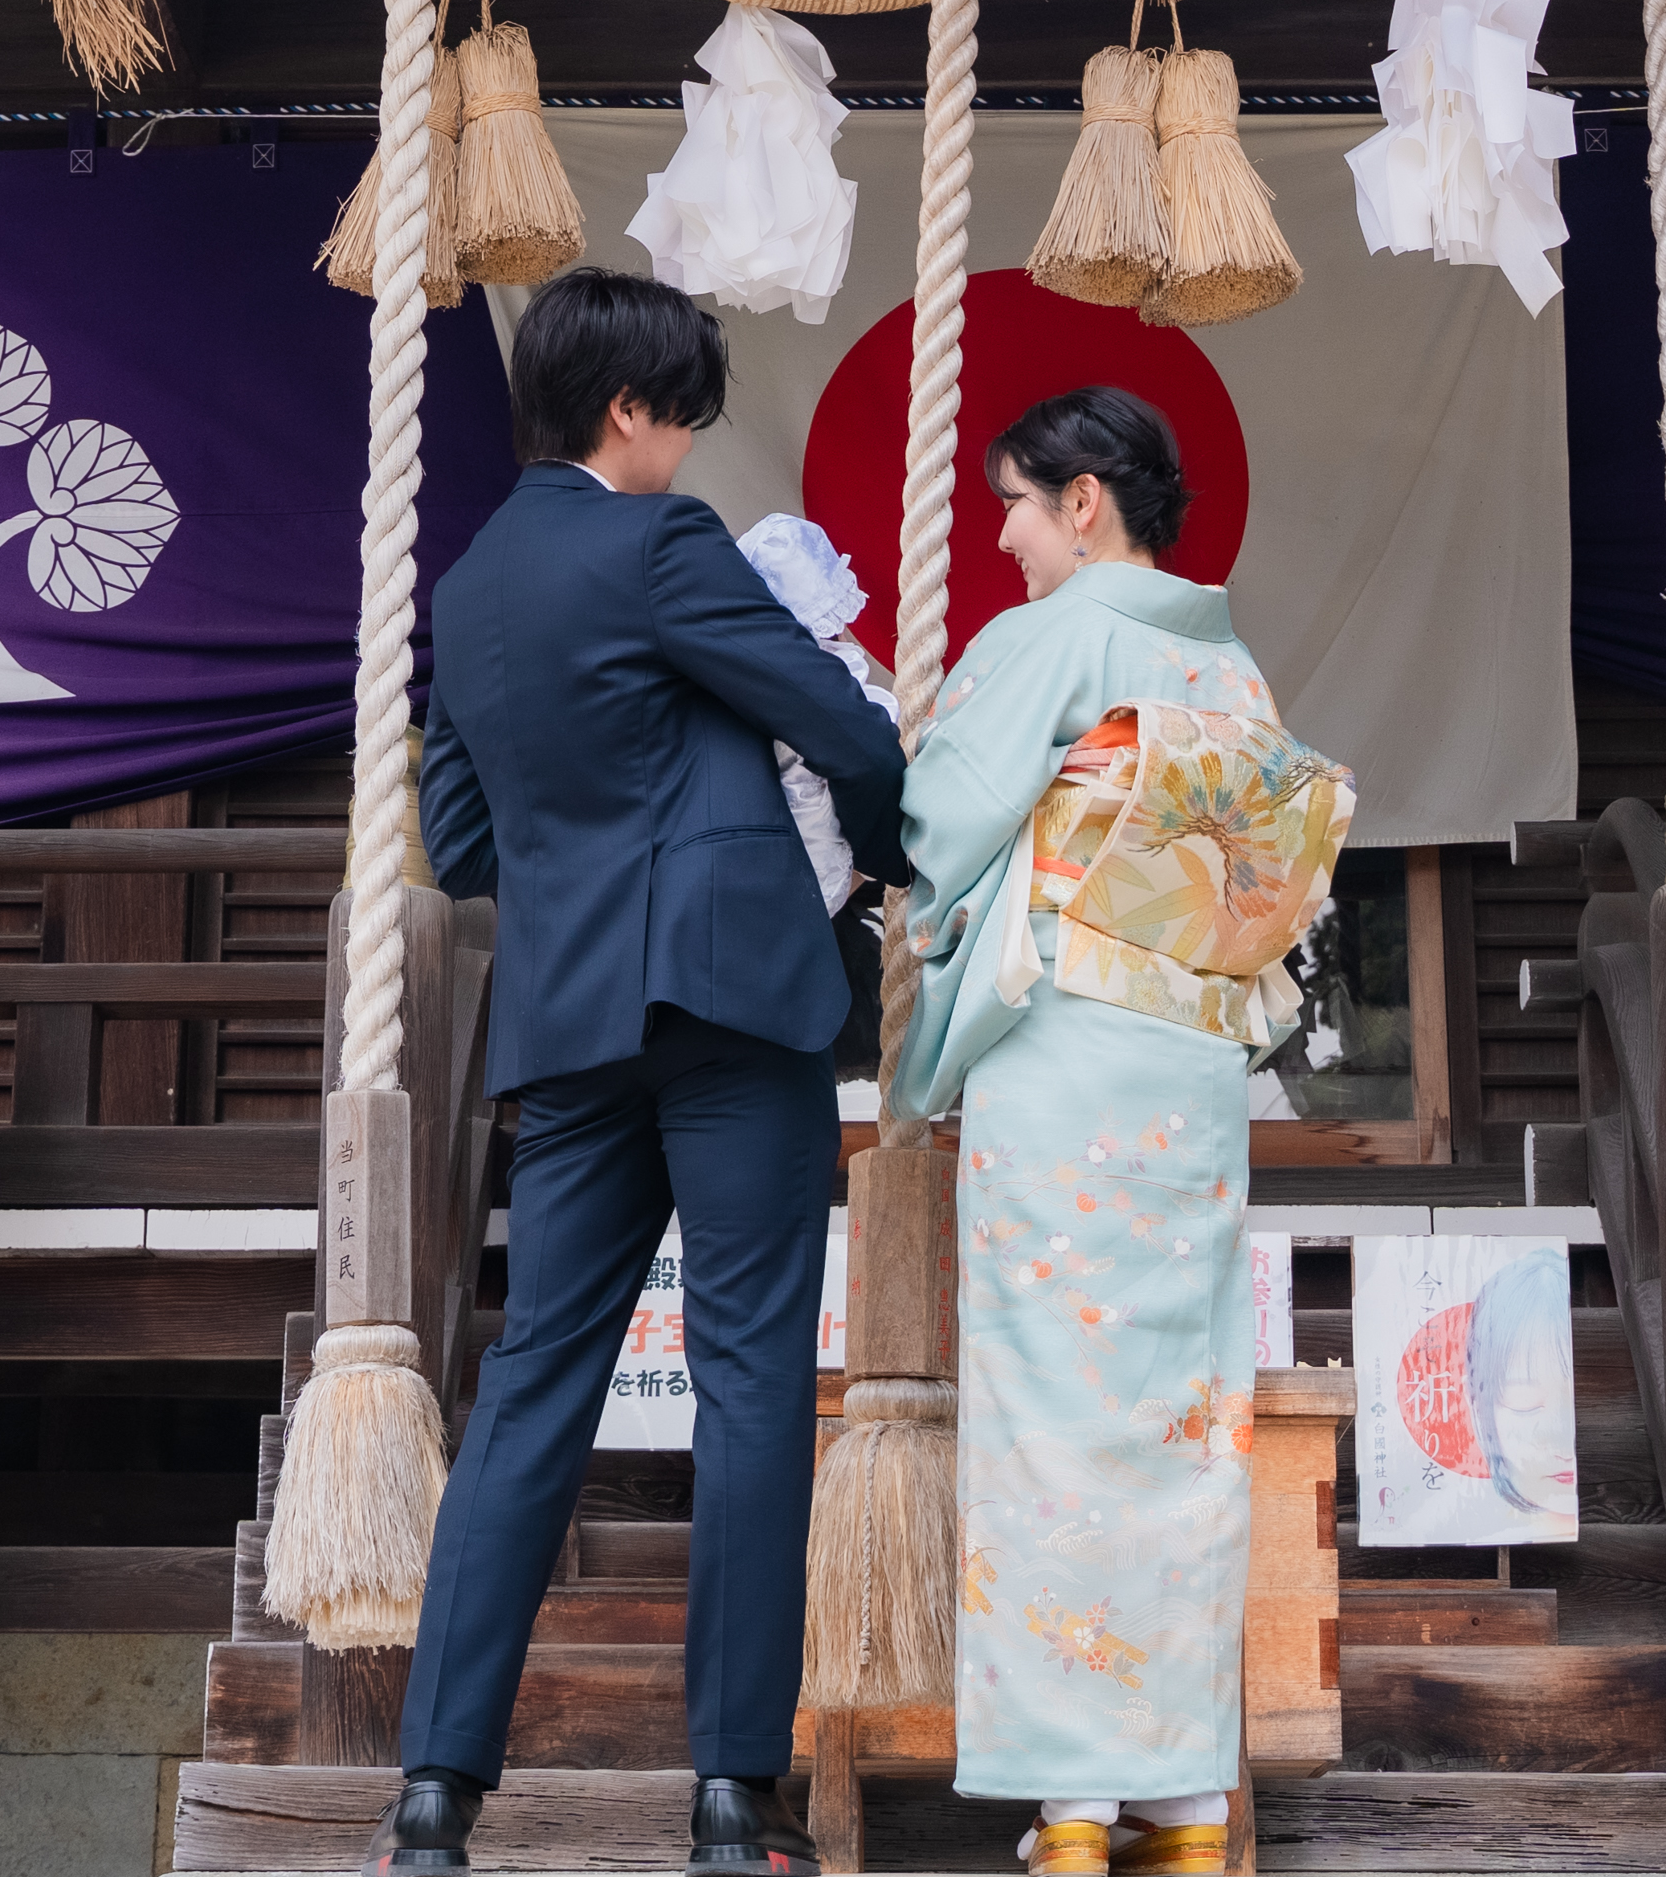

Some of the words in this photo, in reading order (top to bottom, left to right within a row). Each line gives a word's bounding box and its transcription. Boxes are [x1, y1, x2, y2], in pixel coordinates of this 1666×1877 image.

[337, 1139, 356, 1280] 当町住民
[642, 1256, 684, 1291] 殿
[611, 1369, 695, 1398] を祈る
